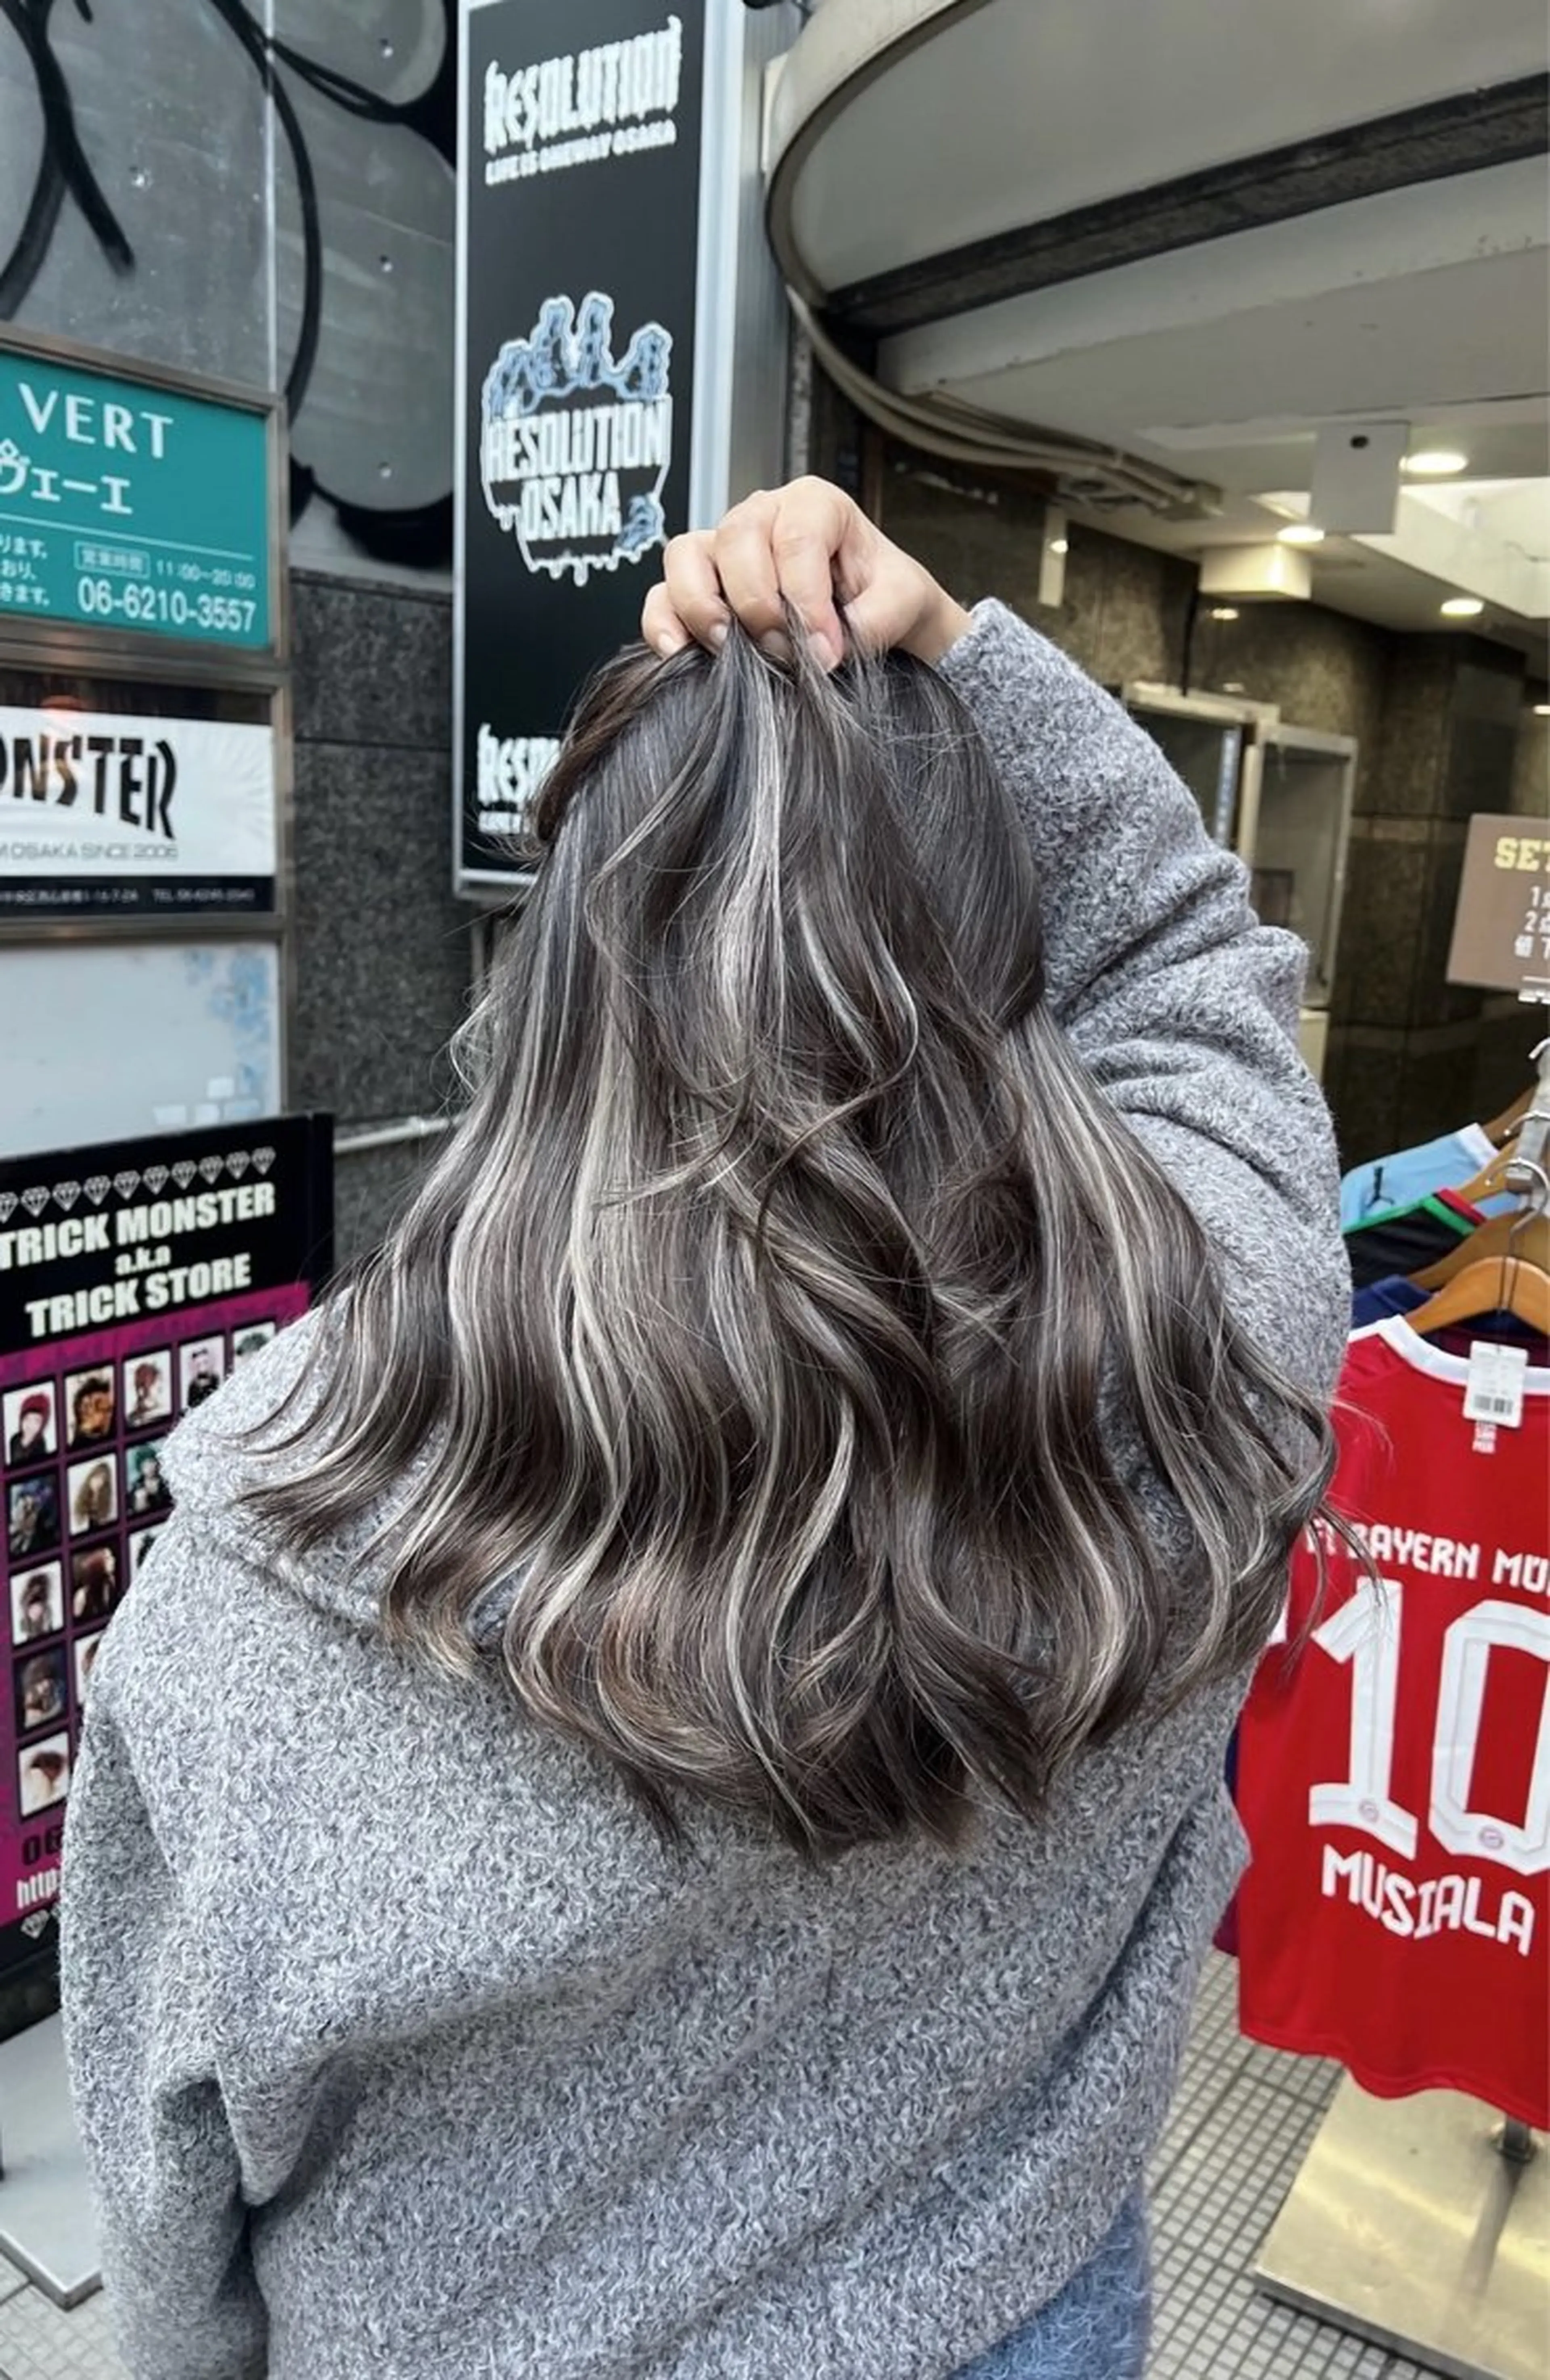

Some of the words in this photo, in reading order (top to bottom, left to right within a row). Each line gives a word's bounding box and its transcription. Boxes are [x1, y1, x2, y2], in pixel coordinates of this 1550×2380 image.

[484, 15, 683, 155] RESOLUTION
[19, 382, 174, 459] VERT
[487, 398, 669, 483] RESOLUTION
[521, 470, 622, 541] OSAKA
[78, 576, 257, 632] 06-6210-3557
[116, 1181, 276, 1245] MONSTER
[25, 1278, 140, 1338] TRICK
[145, 1252, 252, 1310] STORE
[1347, 1523, 1480, 1579] BAYERN
[1492, 1548, 1550, 1598] MÜ
[1307, 1575, 1550, 1877] 10
[1322, 1843, 1535, 1957] MUSIALA
